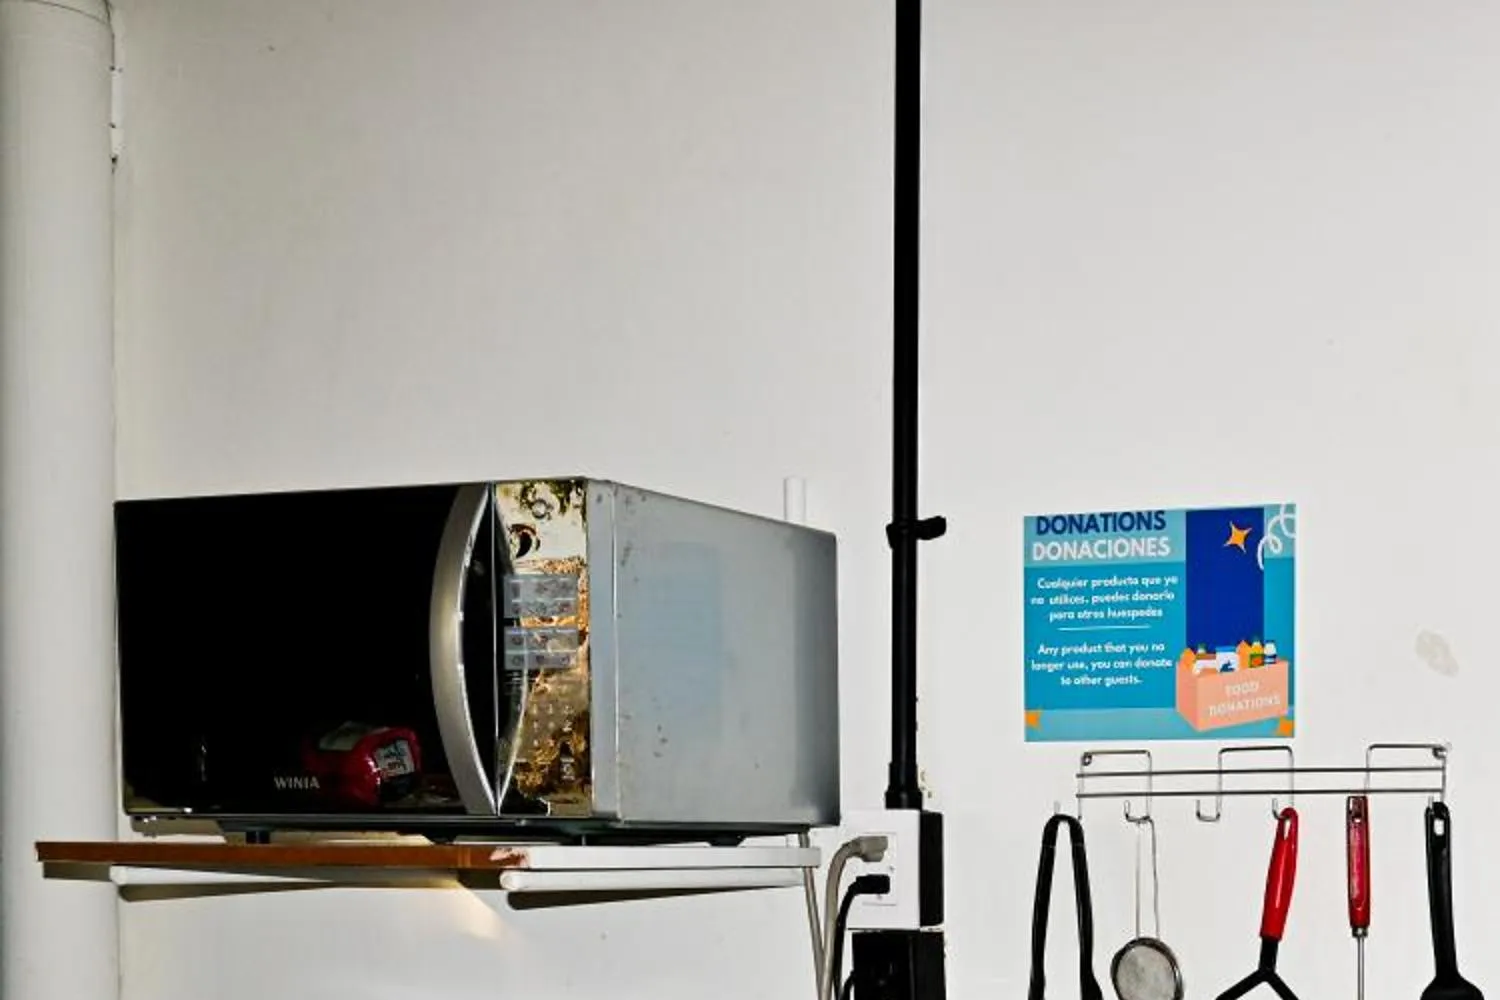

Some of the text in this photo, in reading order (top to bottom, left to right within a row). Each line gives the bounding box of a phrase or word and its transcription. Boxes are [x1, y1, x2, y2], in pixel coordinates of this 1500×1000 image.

[1036, 510, 1166, 535] DONATIONS
[1033, 537, 1171, 561] DONACIONES
[1037, 576, 1087, 590] Cualquier
[1091, 575, 1139, 589] producto
[1141, 577, 1162, 587] que
[1031, 597, 1044, 605] no
[1091, 591, 1129, 605] puedes
[1131, 589, 1175, 601] donarlo
[1049, 610, 1075, 622] para
[1077, 609, 1104, 619] otros
[1038, 641, 1165, 656] Any product that you no
[1031, 660, 1064, 673] longer
[1091, 661, 1111, 672] you
[1113, 660, 1133, 668] can
[1134, 657, 1173, 668] donate
[1061, 676, 1071, 685] to
[1074, 675, 1101, 685] other
[1208, 696, 1281, 716] DONATIONS
[273, 776, 320, 789] WINIA
